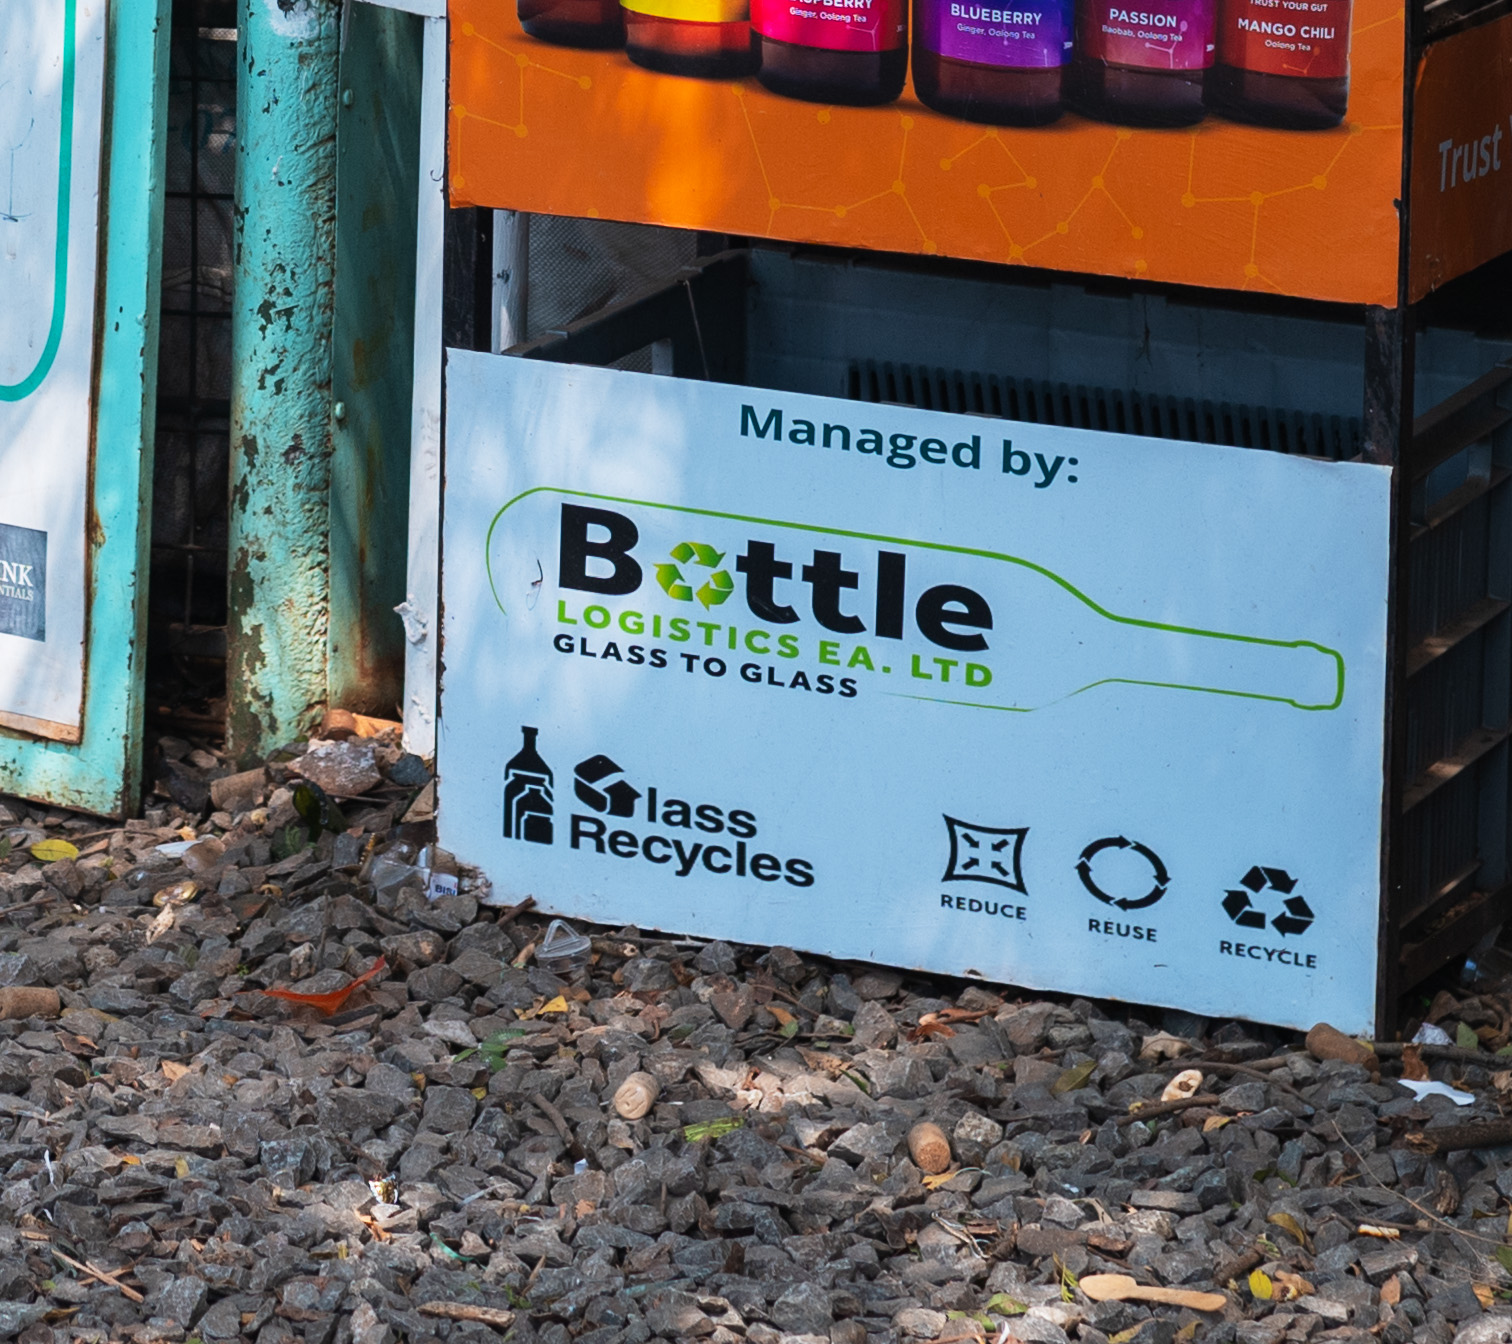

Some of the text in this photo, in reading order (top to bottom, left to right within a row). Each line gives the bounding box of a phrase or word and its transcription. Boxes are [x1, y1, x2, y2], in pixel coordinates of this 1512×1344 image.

[951, 3, 1041, 24] BLUEBERRY
[1109, 8, 1176, 27] PASSION
[1238, 18, 1334, 39] MANGO CHILI
[1439, 124, 1502, 192] Trust
[740, 404, 1078, 488] Managed by:
[553, 633, 857, 697] GLASS TO GLASS
[557, 599, 992, 687] LOGISTICS EA. LTD
[570, 813, 814, 887] Recycles
[941, 894, 1316, 968] REDUCE REUSE RECYCLE
